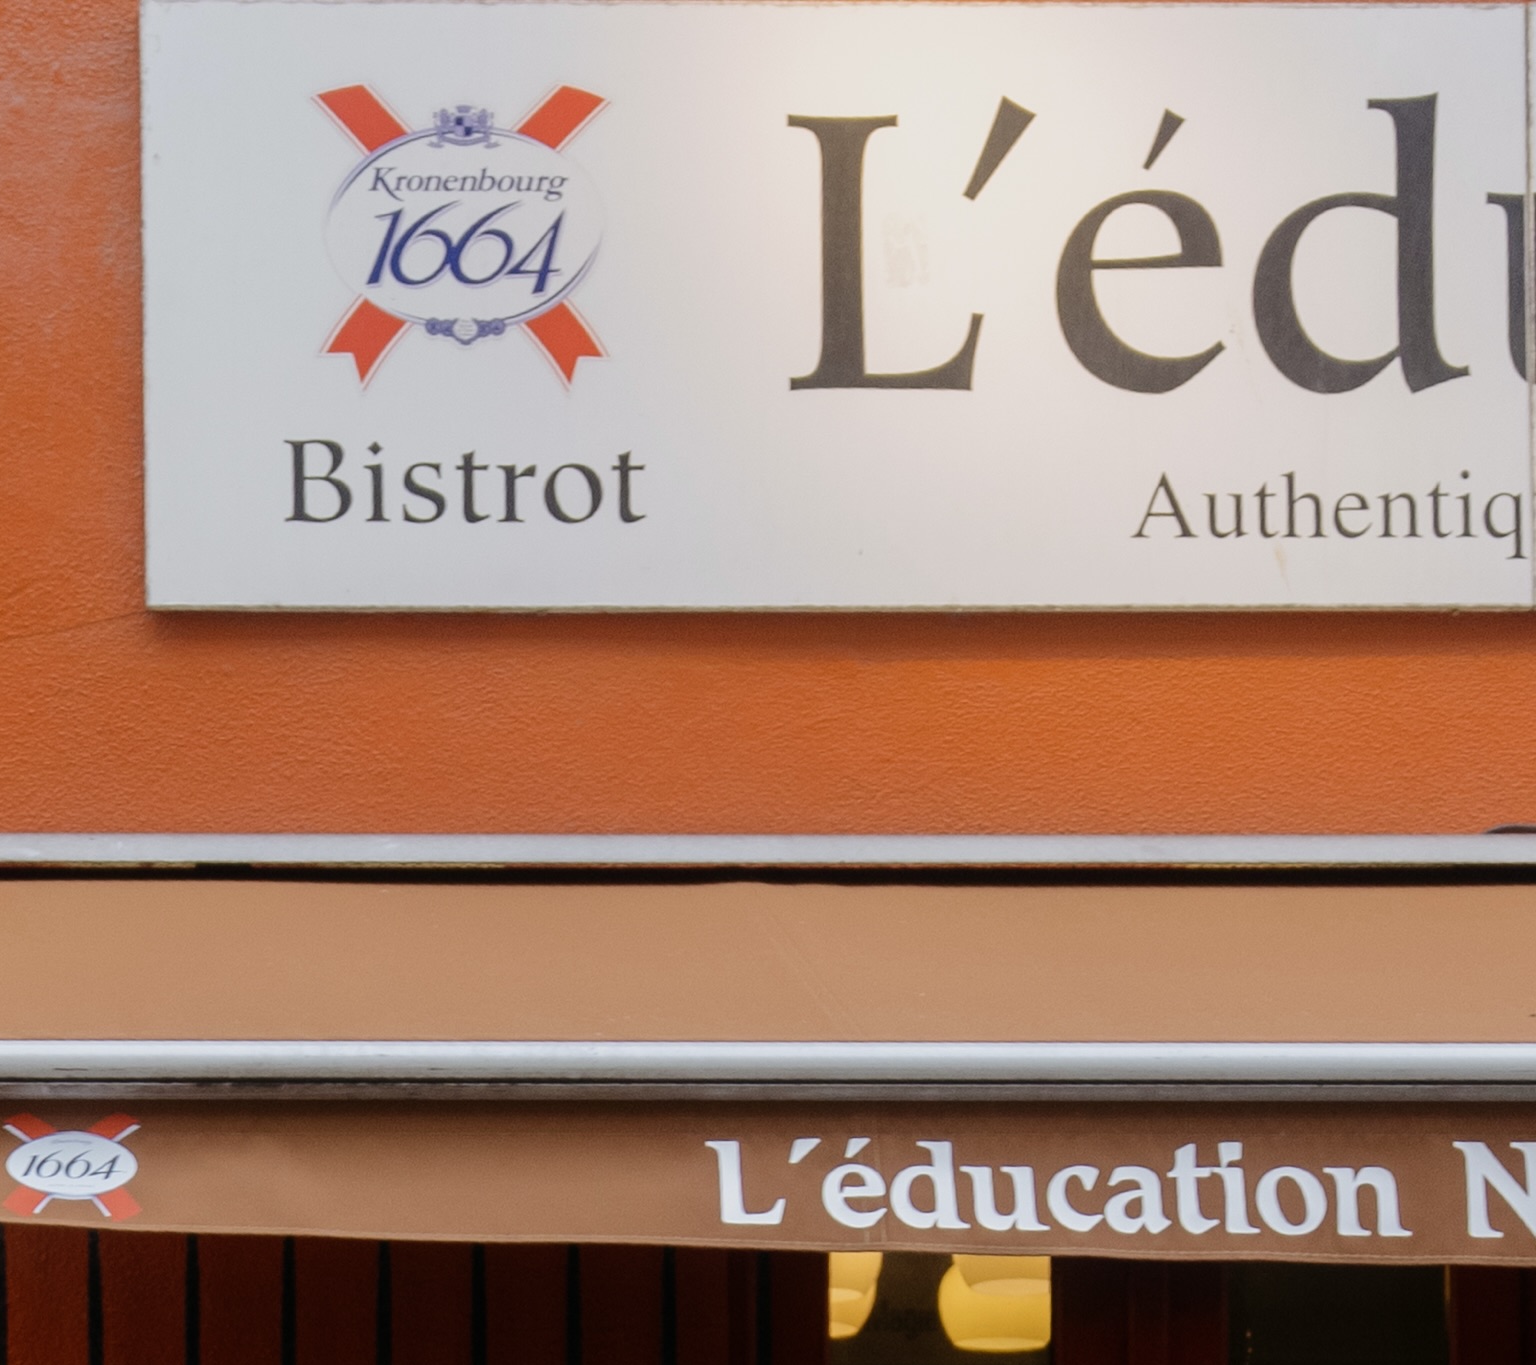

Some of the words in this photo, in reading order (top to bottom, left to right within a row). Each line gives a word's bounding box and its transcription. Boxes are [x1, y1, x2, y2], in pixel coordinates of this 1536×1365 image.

[366, 166, 569, 202] Kronenbourg
[366, 201, 567, 295] 1664
[786, 92, 1536, 396] L'éd
[283, 438, 647, 524] Bistrot
[21, 1149, 127, 1180] 1664
[704, 1136, 1414, 1238] L'éducation
[1452, 1139, 1536, 1239] N
